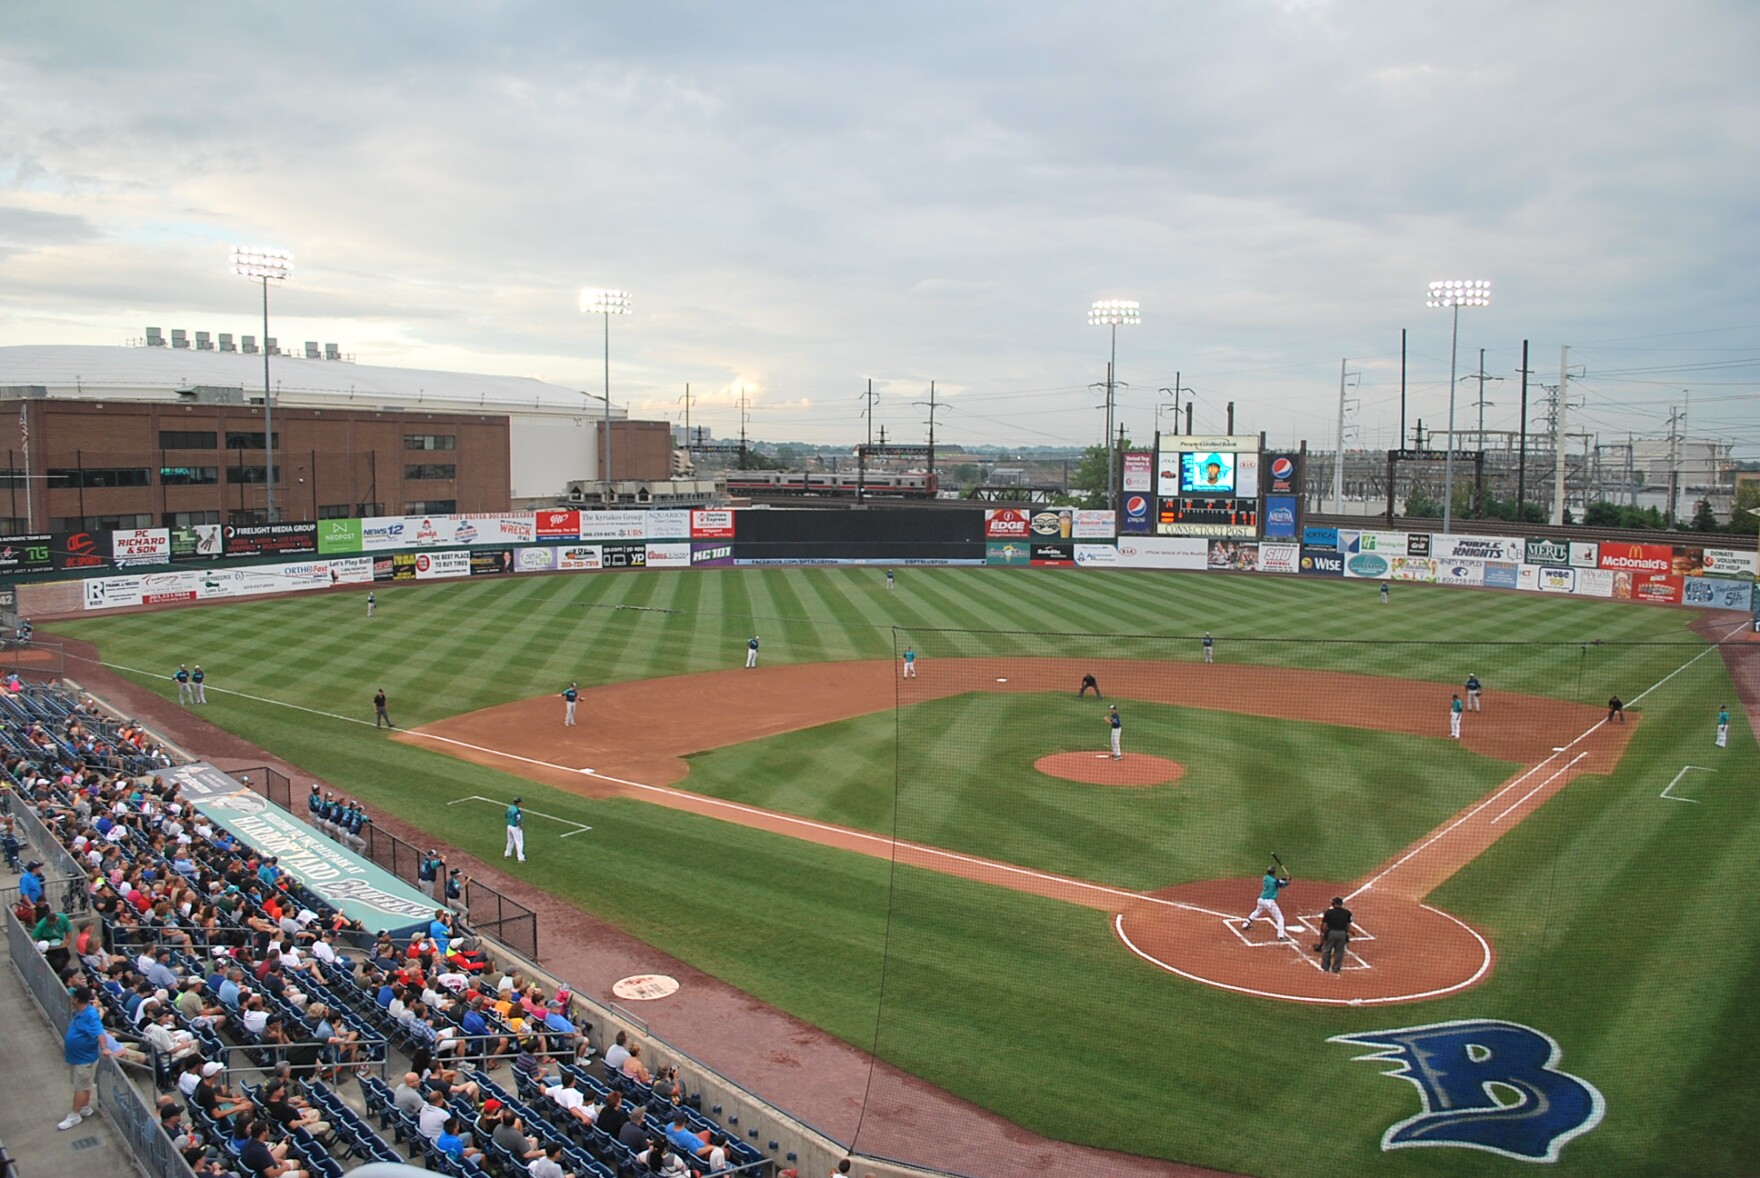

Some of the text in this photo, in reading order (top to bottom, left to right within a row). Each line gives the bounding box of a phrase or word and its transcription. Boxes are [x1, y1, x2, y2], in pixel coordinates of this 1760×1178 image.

[623, 514, 642, 522] Group
[236, 524, 316, 535] FIRELIGHT MEDIA GROUP
[387, 524, 404, 535] 12
[500, 524, 532, 536] WRECK
[990, 521, 1025, 530] EDGE
[1165, 525, 1248, 536] CONNECTICUT POST
[135, 530, 149, 538] PC
[325, 533, 355, 541] NEOPOST
[118, 537, 166, 547] RICHARD
[1458, 540, 1501, 549] PURPLE
[136, 545, 157, 554] SON
[1264, 548, 1293, 561] SHU
[1452, 547, 1504, 559] KNIGHTS
[1527, 543, 1567, 558] MERIT
[631, 553, 645, 562] yp
[1602, 555, 1668, 570] McDonald's
[313, 564, 328, 572] Fast
[1314, 557, 1342, 571] WISE
[229, 816, 341, 880] HARBOR YARD
[315, 878, 438, 918] BLUEFISH
[1324, 1018, 1606, 1163] B
